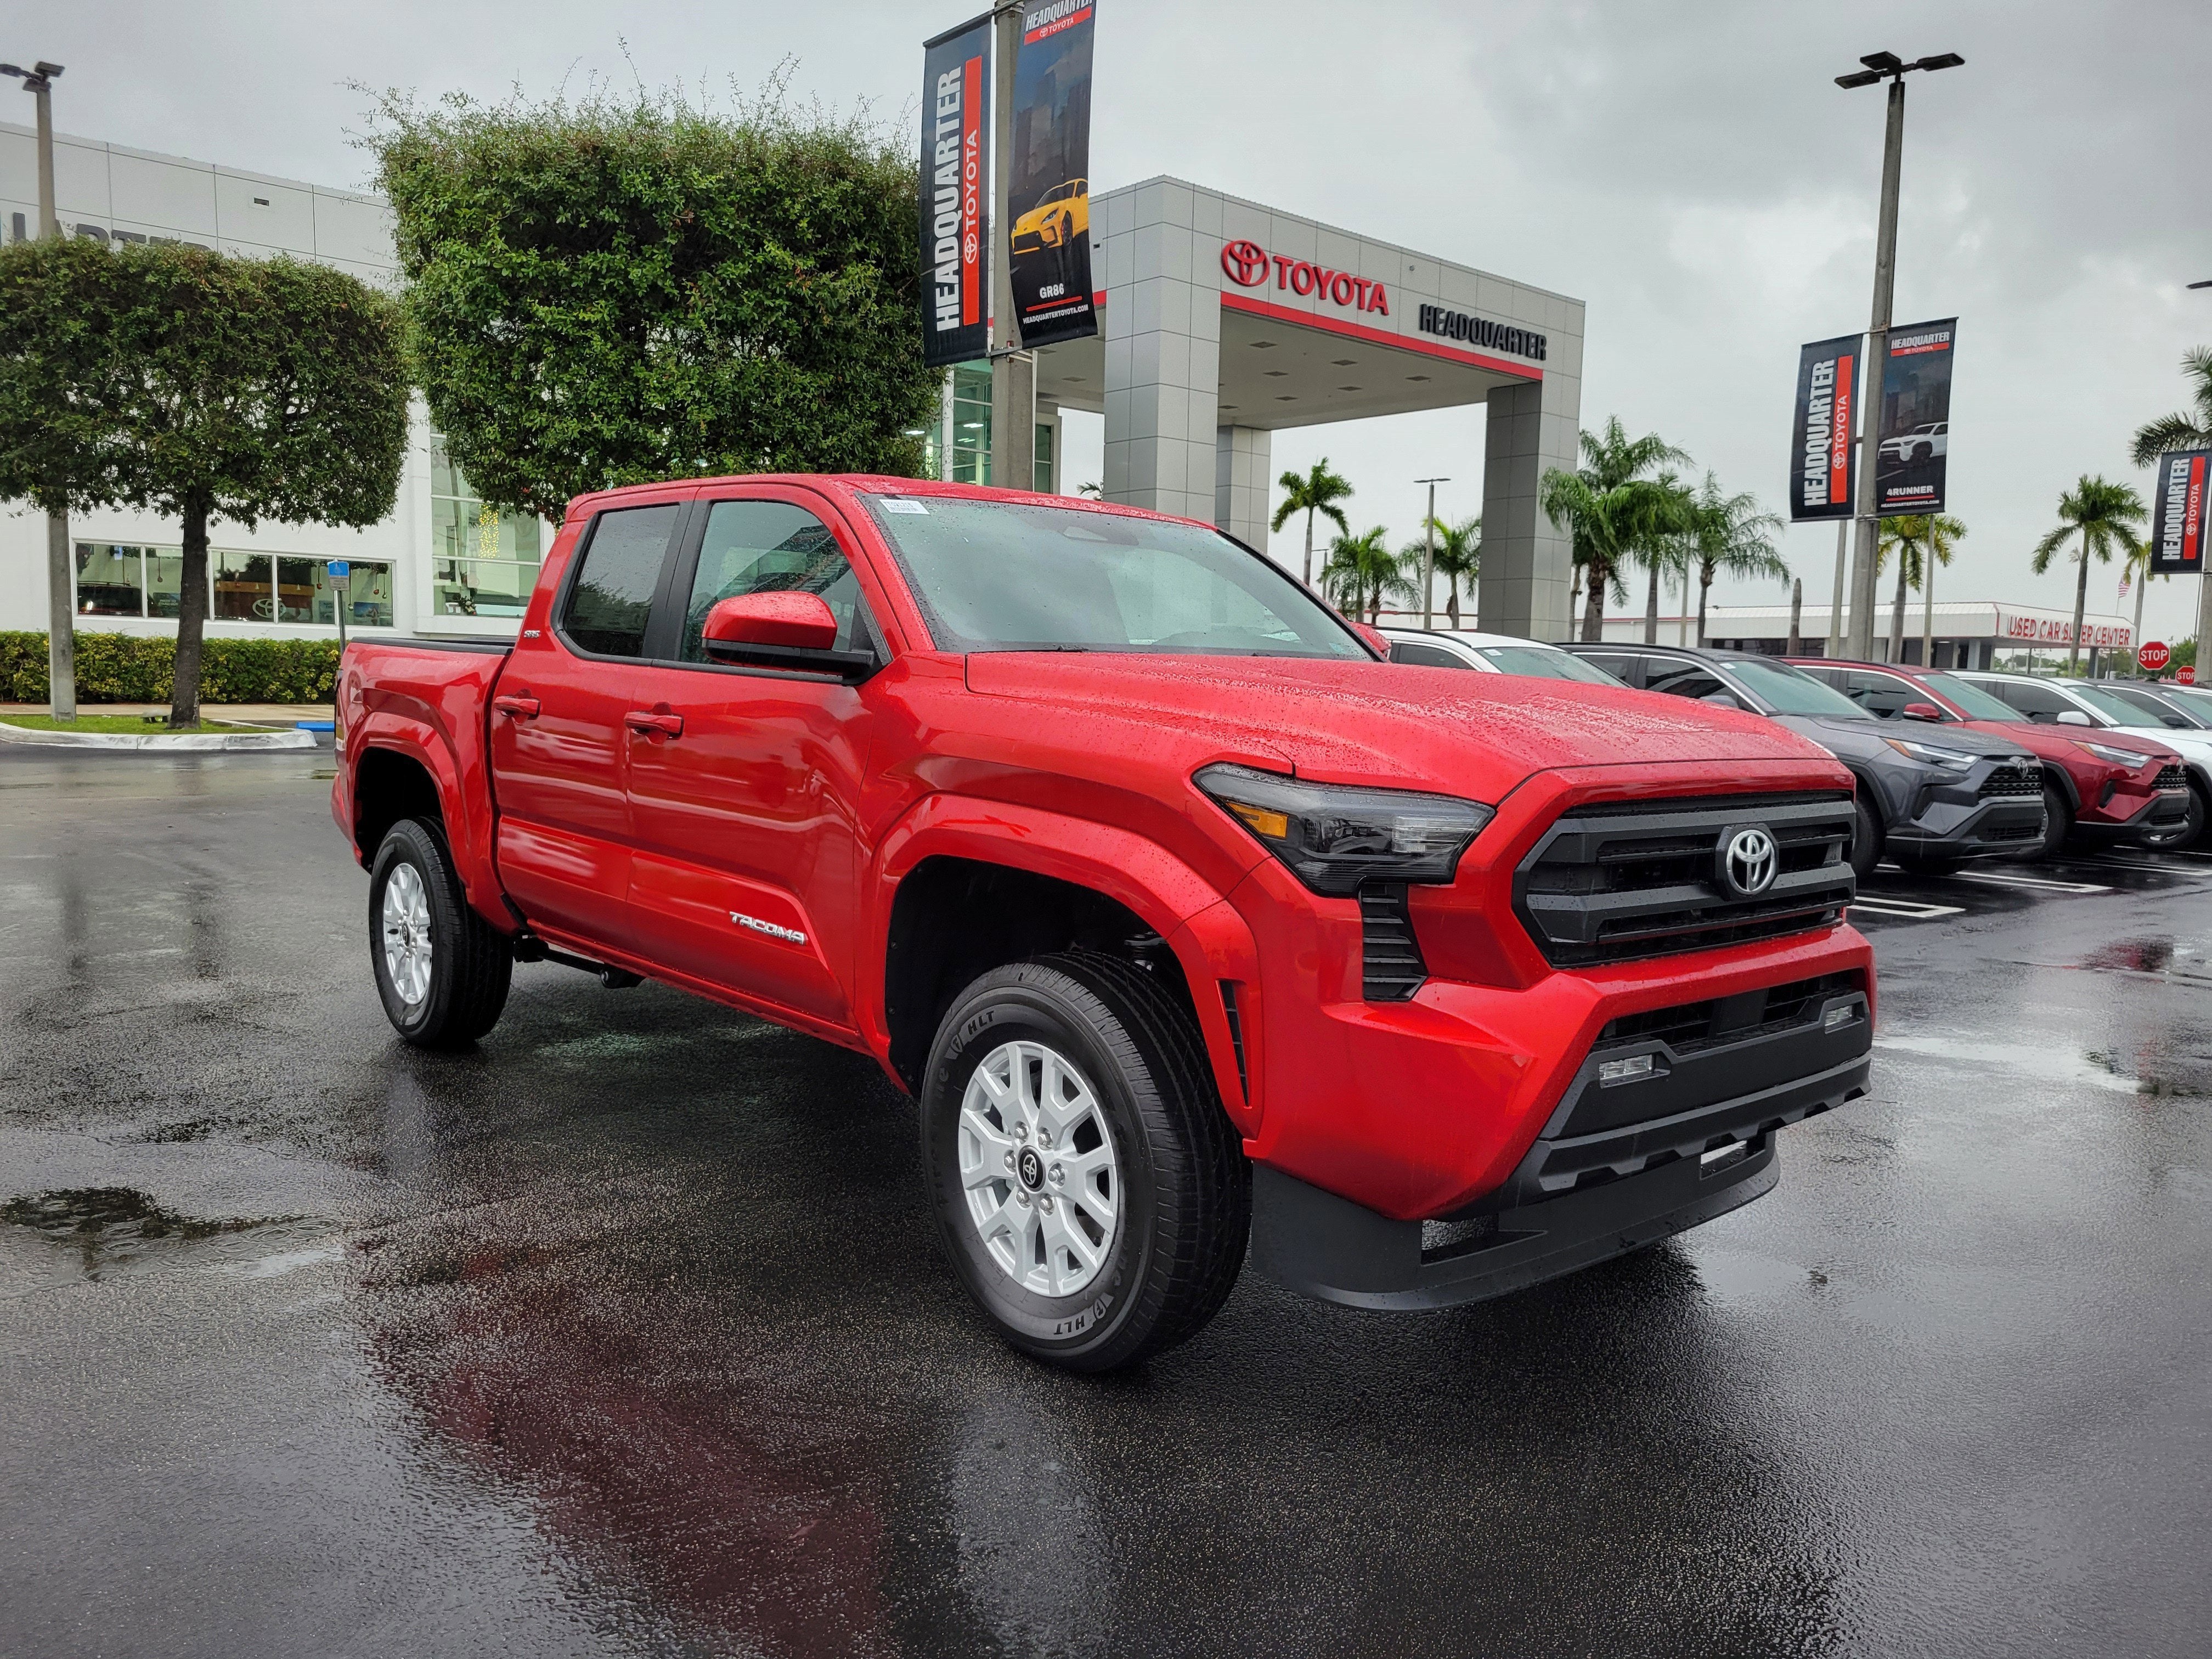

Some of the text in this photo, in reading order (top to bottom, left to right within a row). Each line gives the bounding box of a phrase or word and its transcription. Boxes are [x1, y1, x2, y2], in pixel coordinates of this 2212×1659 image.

[1025, 0, 1093, 32] HEADQUART
[1048, 17, 1074, 33] TOYOTA
[966, 129, 977, 232] TOYOTA
[934, 66, 962, 331] HEADQUARTER
[1040, 283, 1064, 299] GR86
[1273, 256, 1389, 315] TOYOTA
[1023, 304, 1089, 324] HEADQUARTERTOYOTA.COM
[1419, 304, 1546, 360] HEADQUARTER
[1891, 331, 1950, 350] HEADQUARTER
[1911, 346, 1933, 354] TOYOTA
[1804, 359, 1835, 506] HEADQUARTER
[1835, 395, 1847, 450] TOYOTA
[1887, 486, 1933, 496] 4RUNNER
[2188, 483, 2199, 522] TOYOTA
[2162, 458, 2190, 560] HEADQUARTER
[2008, 616, 2130, 646] USED CAR SUER CENTER
[2140, 649, 2168, 661] STOP
[729, 911, 808, 945] TACOMA
[967, 1010, 994, 1035] HLT
[1053, 1315, 1085, 1335] HLT
